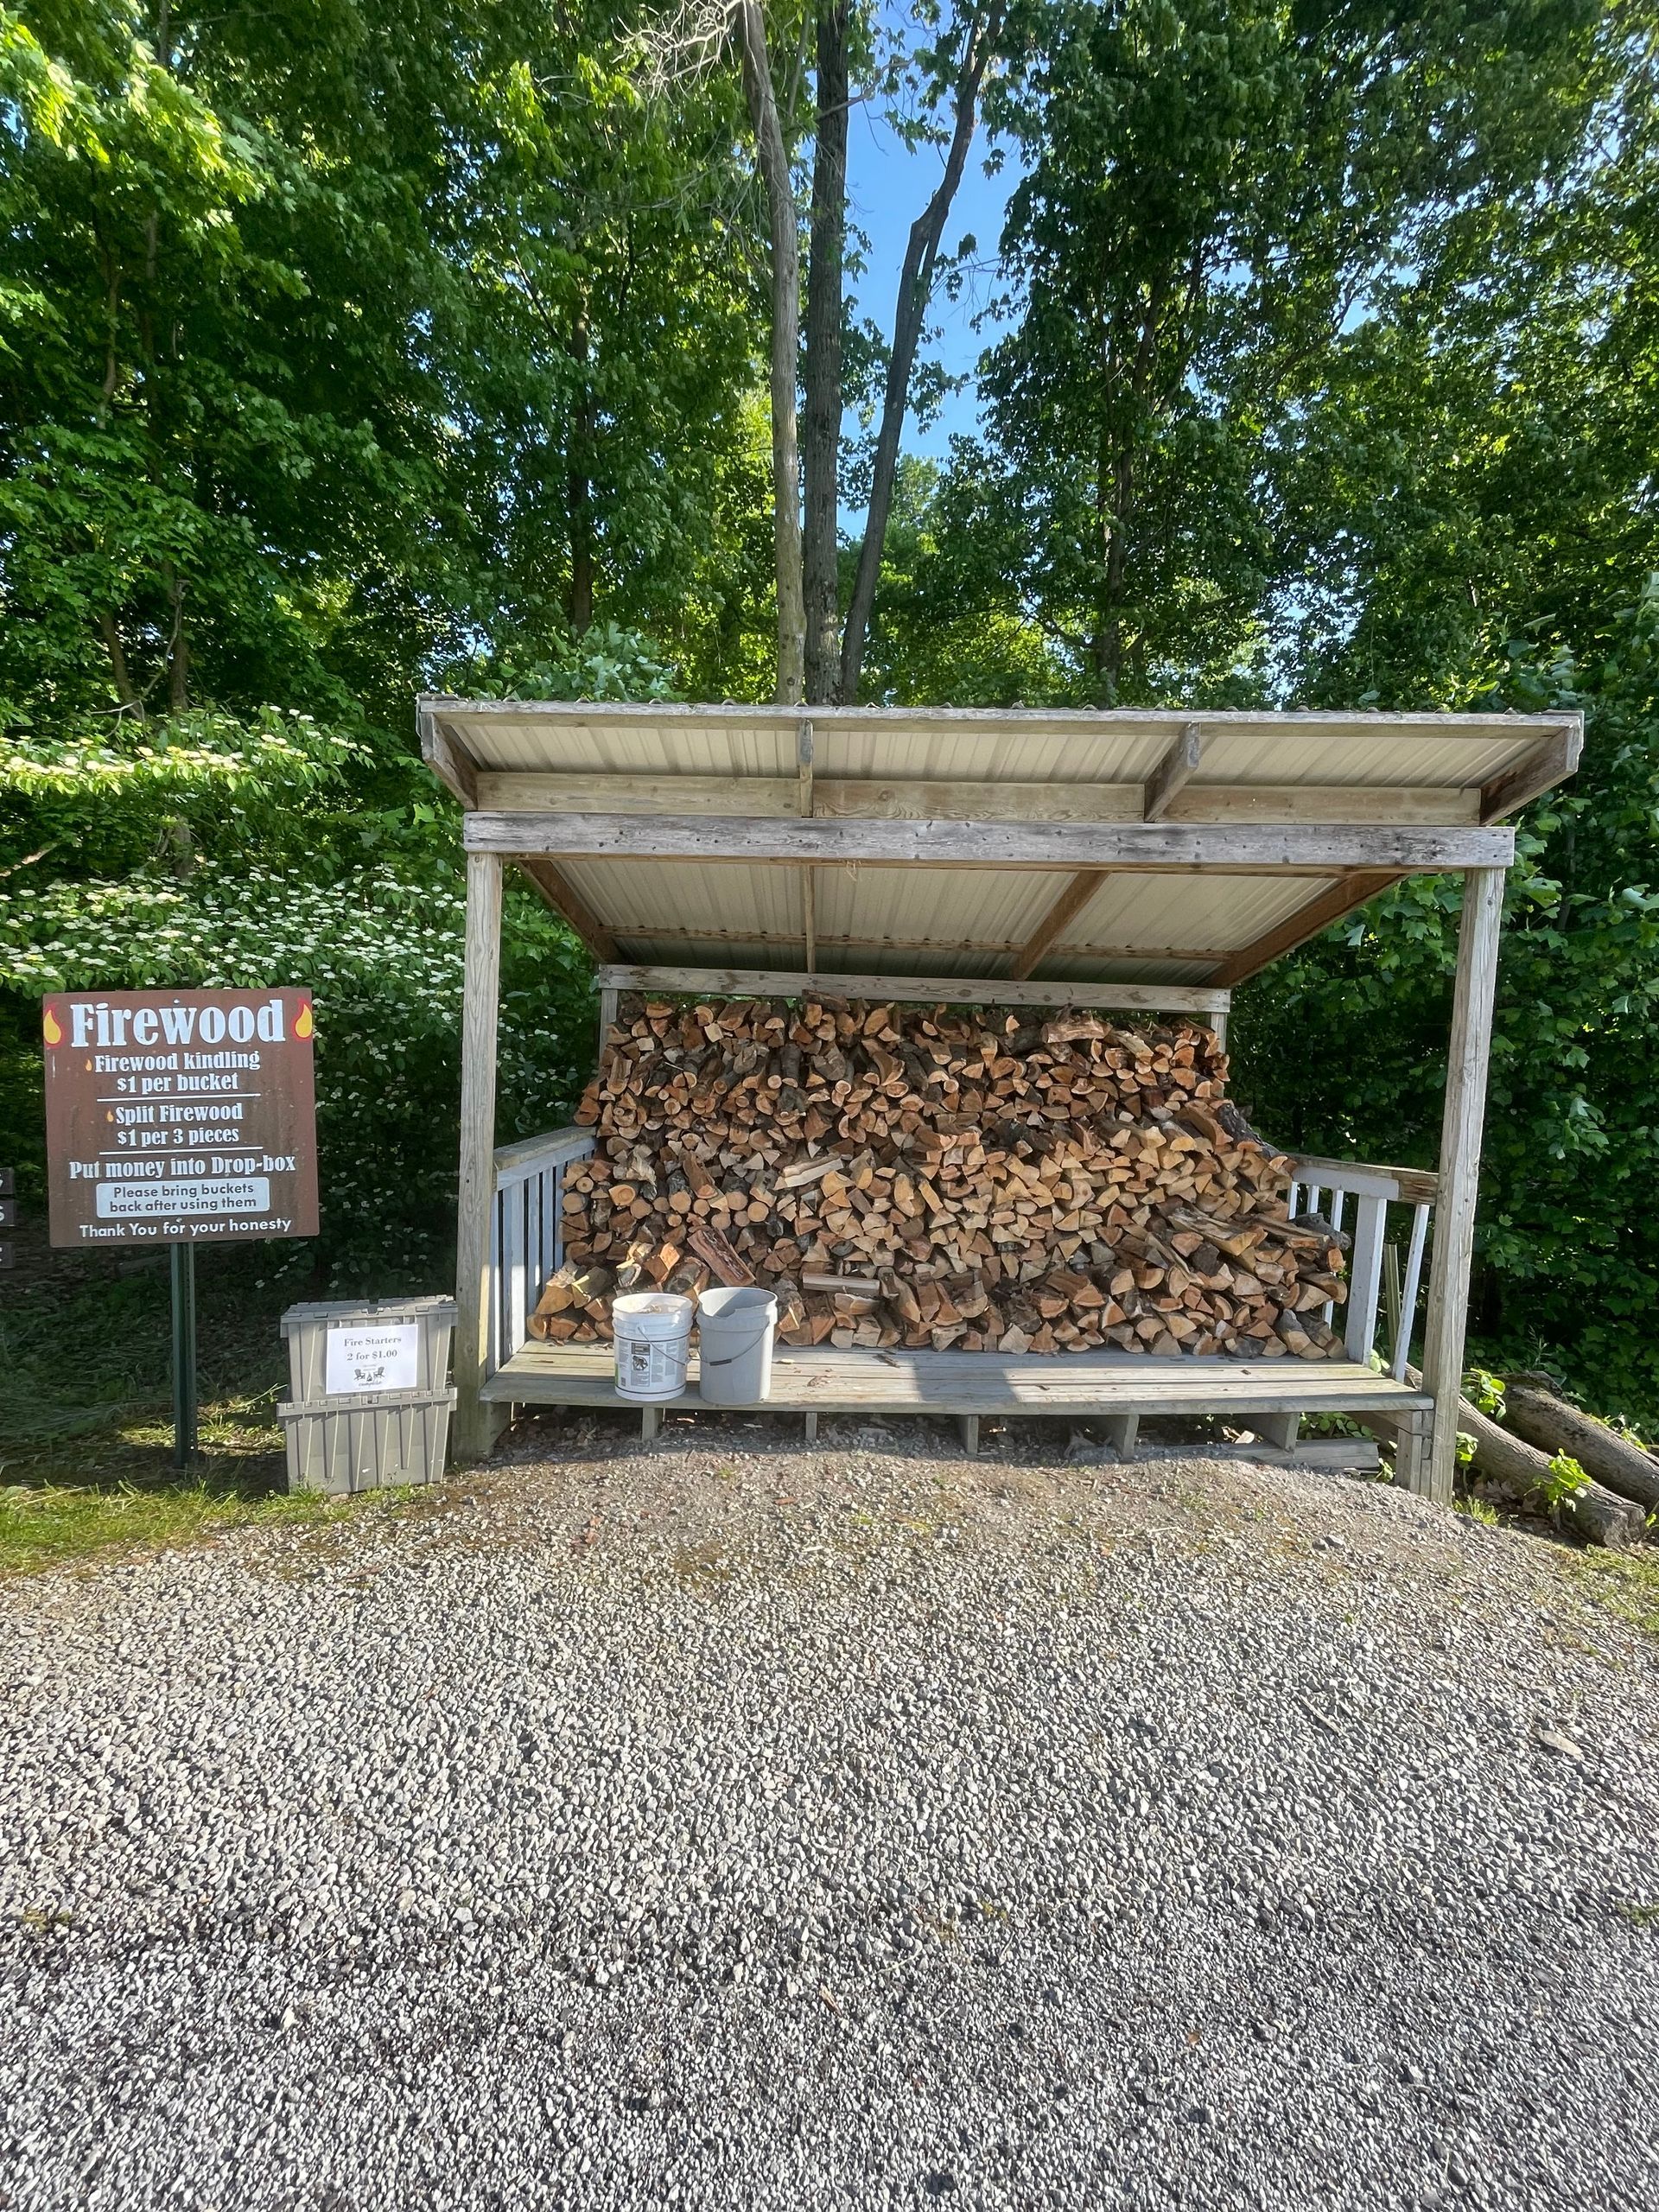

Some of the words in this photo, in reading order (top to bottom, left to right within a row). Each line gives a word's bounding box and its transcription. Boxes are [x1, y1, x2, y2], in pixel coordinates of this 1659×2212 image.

[70, 1000, 285, 1047] Firewood
[94, 1054, 178, 1072] Firewood
[183, 1051, 261, 1070] kindling
[118, 1076, 136, 1092] $1
[142, 1077, 171, 1094] per
[177, 1073, 238, 1090] bucket
[116, 1106, 154, 1126] Split
[159, 1103, 243, 1122] Firewood
[118, 1129, 136, 1145] $1
[141, 1128, 168, 1147] per
[173, 1128, 184, 1143] 3
[188, 1127, 239, 1145] pieces
[69, 1161, 100, 1179] Put
[105, 1161, 165, 1179] money
[170, 1158, 206, 1176] into
[211, 1154, 296, 1175] Drop-box
[113, 1186, 158, 1198] Please
[162, 1185, 197, 1198] bring
[201, 1183, 254, 1194] buckets
[110, 1201, 142, 1212] back
[145, 1200, 176, 1211] after
[180, 1199, 218, 1211] using
[221, 1198, 257, 1208] them
[79, 1225, 125, 1237] Thank
[129, 1224, 157, 1236] You
[162, 1222, 185, 1234] for
[189, 1223, 226, 1236] your
[229, 1218, 292, 1232] honesty
[372, 1350, 397, 1359] $1.00
